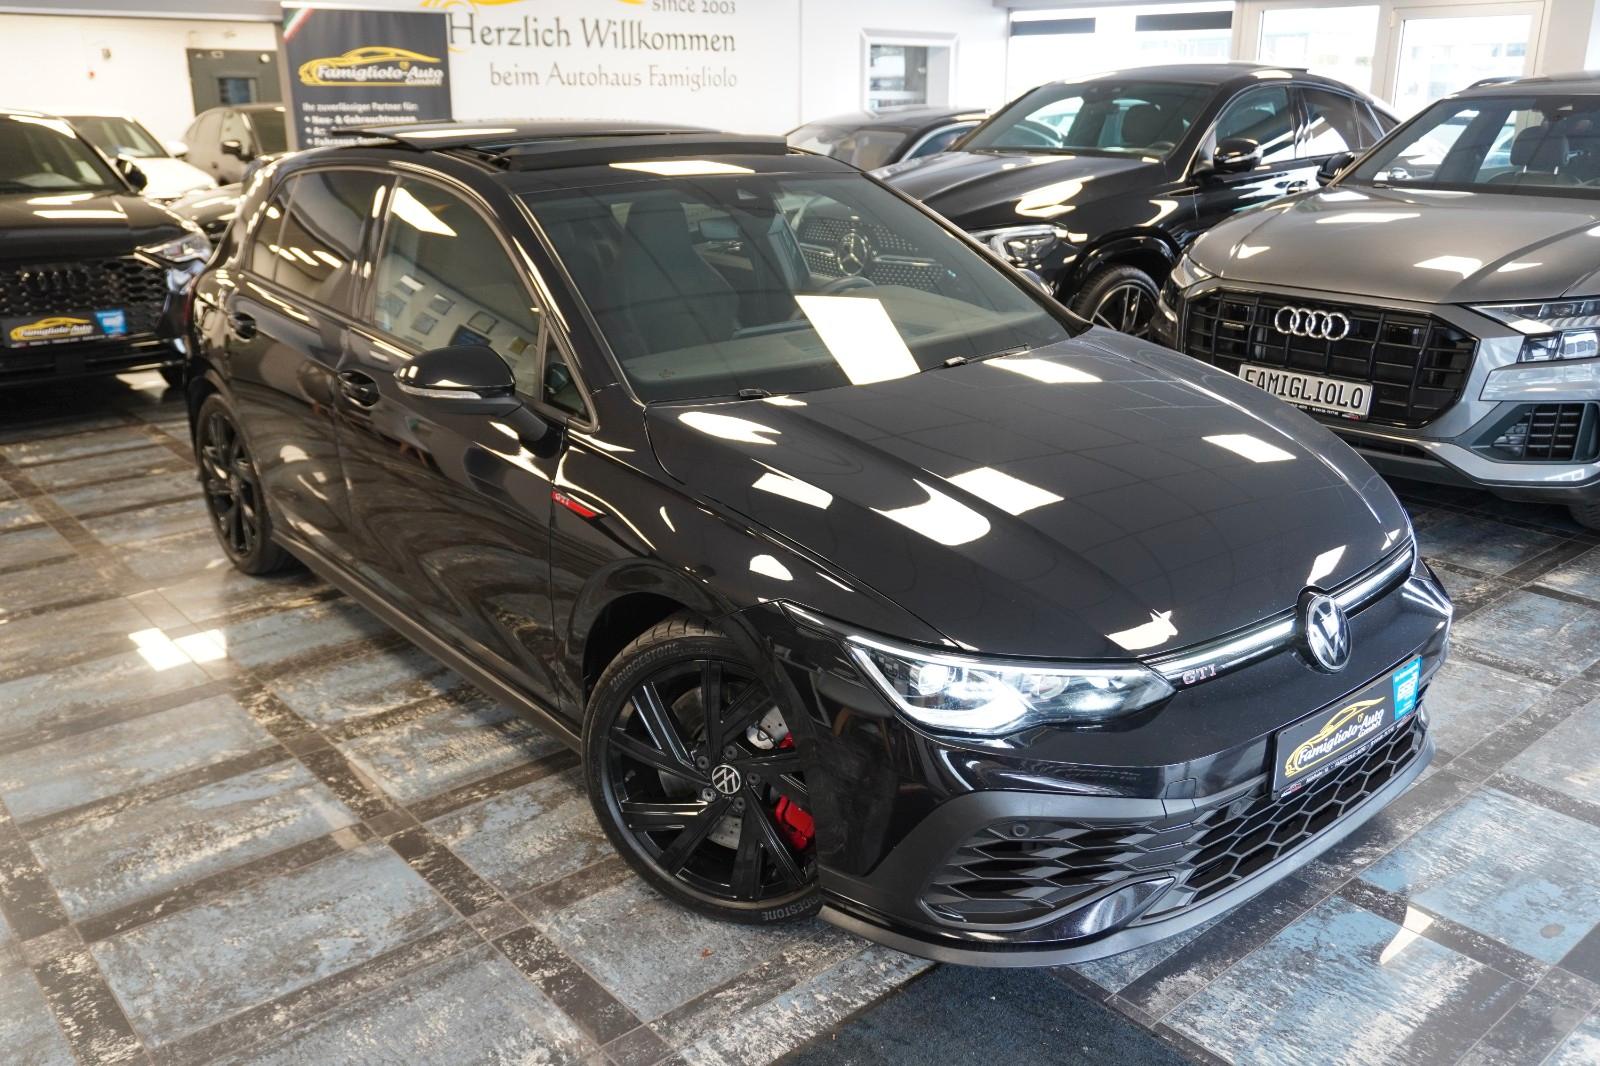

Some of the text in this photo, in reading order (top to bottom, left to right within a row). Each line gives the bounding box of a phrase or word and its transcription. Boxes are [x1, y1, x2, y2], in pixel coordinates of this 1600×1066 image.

[651, 0, 736, 14] since 2003
[448, 12, 736, 52] Herzlich Willkommen
[489, 62, 738, 92] beim Autohaus Famigliolo
[1244, 369, 1364, 409] FAMIGLIOLO
[1182, 663, 1217, 685] GTI
[1297, 708, 1385, 765] Famigliolo-Auto
